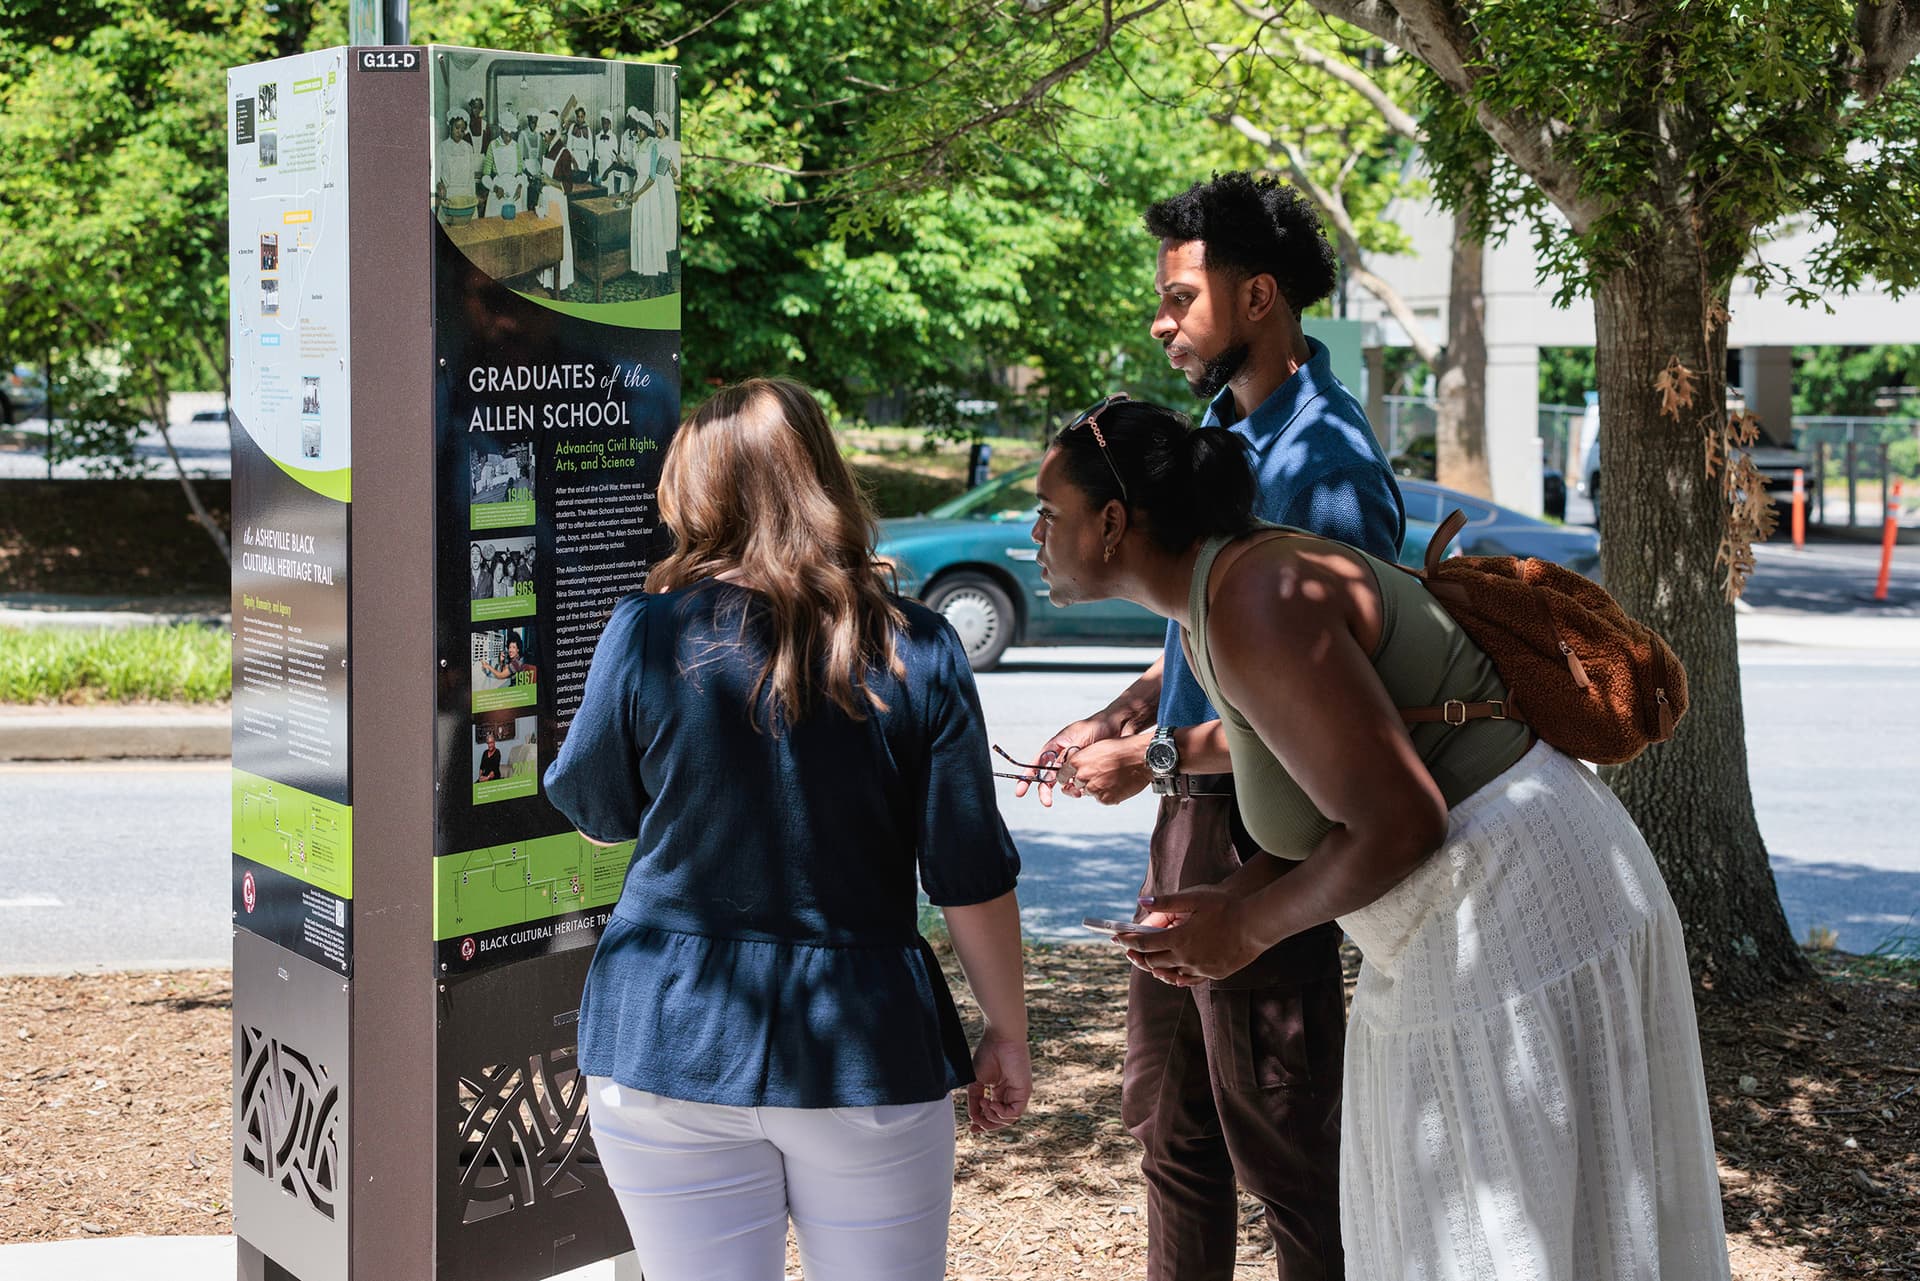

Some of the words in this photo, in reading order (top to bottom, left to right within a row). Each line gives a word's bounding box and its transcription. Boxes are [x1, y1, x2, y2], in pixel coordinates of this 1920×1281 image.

[364, 53, 415, 68] G11-D
[469, 364, 595, 392] GRADUATES
[600, 364, 621, 400] of
[624, 363, 651, 387] the
[469, 404, 534, 432] ALLEN
[543, 401, 630, 429] SCHOOL
[555, 441, 604, 455] Advancing
[608, 439, 627, 452] Civil
[630, 437, 658, 453] Rights,
[556, 459, 577, 472] Arts,
[581, 456, 598, 470] and
[602, 456, 635, 468] Science
[507, 487, 533, 502] 1940s
[243, 526, 253, 546] the
[255, 528, 290, 550] ASHEVILLE
[292, 533, 315, 555] BLACK
[556, 535, 567, 543] girls,
[627, 528, 642, 536] School
[556, 546, 574, 554] became
[589, 542, 609, 550] boarding
[243, 552, 276, 575] CULTURAL
[278, 557, 312, 582] HERITAGE
[314, 564, 334, 585] TRAIL
[578, 564, 593, 572] School
[594, 562, 615, 571] produced
[616, 560, 637, 568] nationally
[514, 580, 534, 596] 1963
[556, 577, 587, 586] internationally
[588, 575, 612, 584] recognized
[587, 587, 601, 595] singer,
[602, 586, 618, 594] pianist,
[566, 601, 579, 609] rights
[556, 626, 578, 634] engineers
[557, 649, 573, 657] School
[557, 659, 584, 669] successfully
[516, 670, 535, 687] 1967
[557, 673, 571, 682] public
[557, 683, 584, 694] participated
[557, 696, 573, 705] around
[480, 936, 508, 952] BLACK
[511, 925, 553, 945] CULTURAL
[555, 916, 595, 936] HERITAGE
